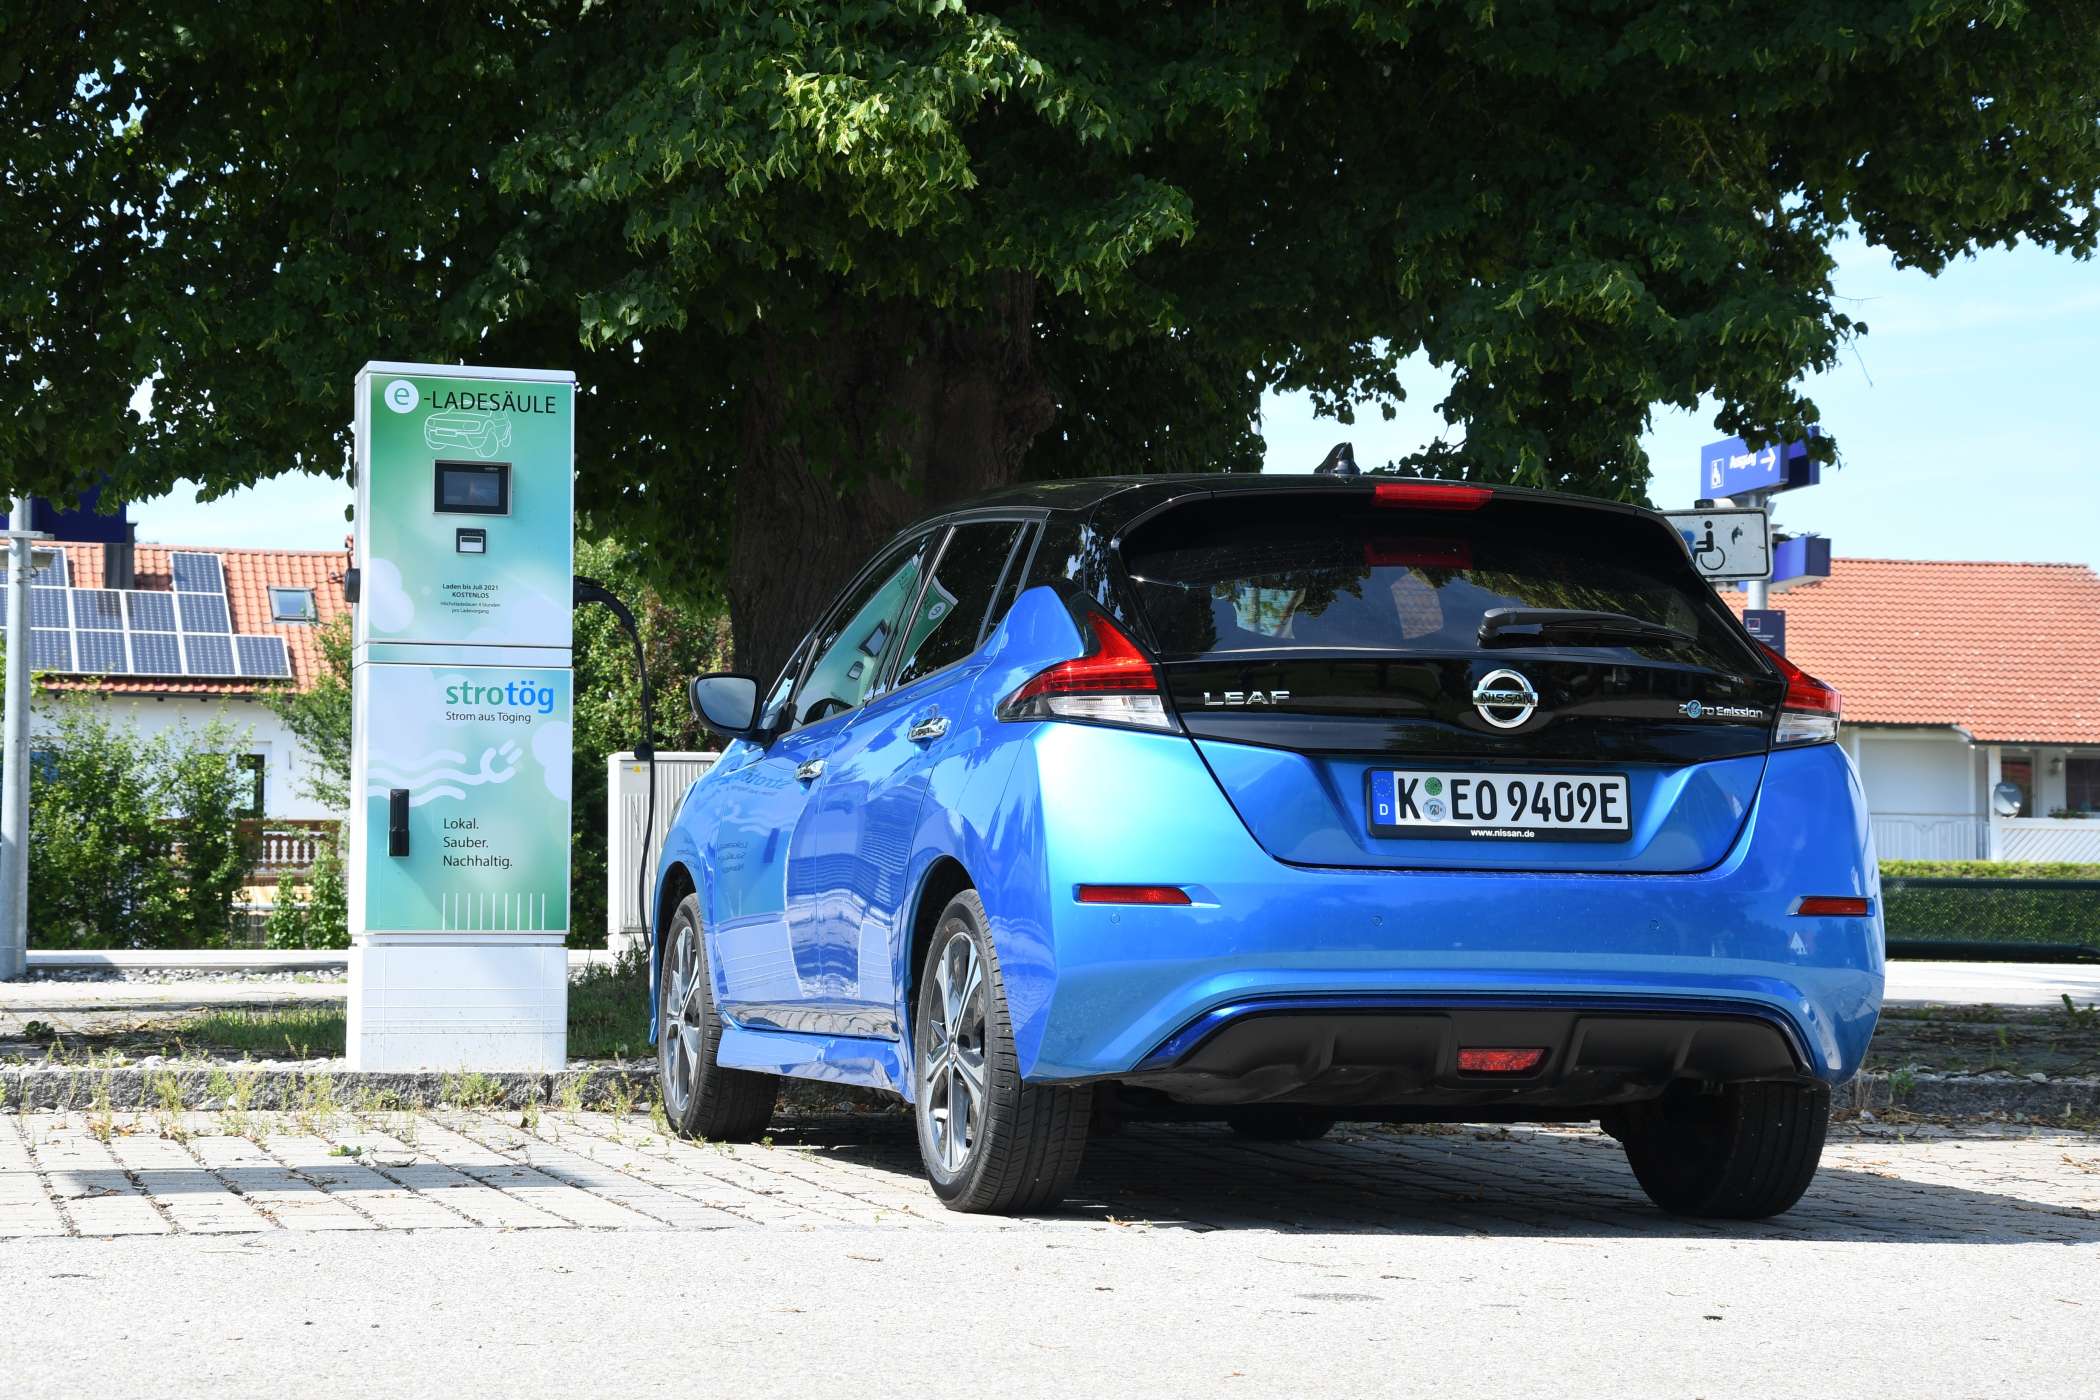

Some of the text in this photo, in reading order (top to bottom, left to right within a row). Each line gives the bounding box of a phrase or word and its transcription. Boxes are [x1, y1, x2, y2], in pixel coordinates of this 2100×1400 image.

[452, 591, 490, 599] KOSTENLOS
[446, 680, 554, 714] strotög
[1203, 690, 1290, 706] LEAF
[1479, 691, 1534, 705] NISSAN
[446, 711, 532, 724] Strom aus Töging
[1397, 778, 1421, 820] K
[1507, 780, 1623, 824] 9409E
[1379, 803, 1389, 816] D
[443, 817, 480, 830] Lokal.
[1470, 829, 1535, 838] www.nissan.de
[443, 836, 489, 849] Sauber.
[443, 855, 513, 870] Nachhaltig.
